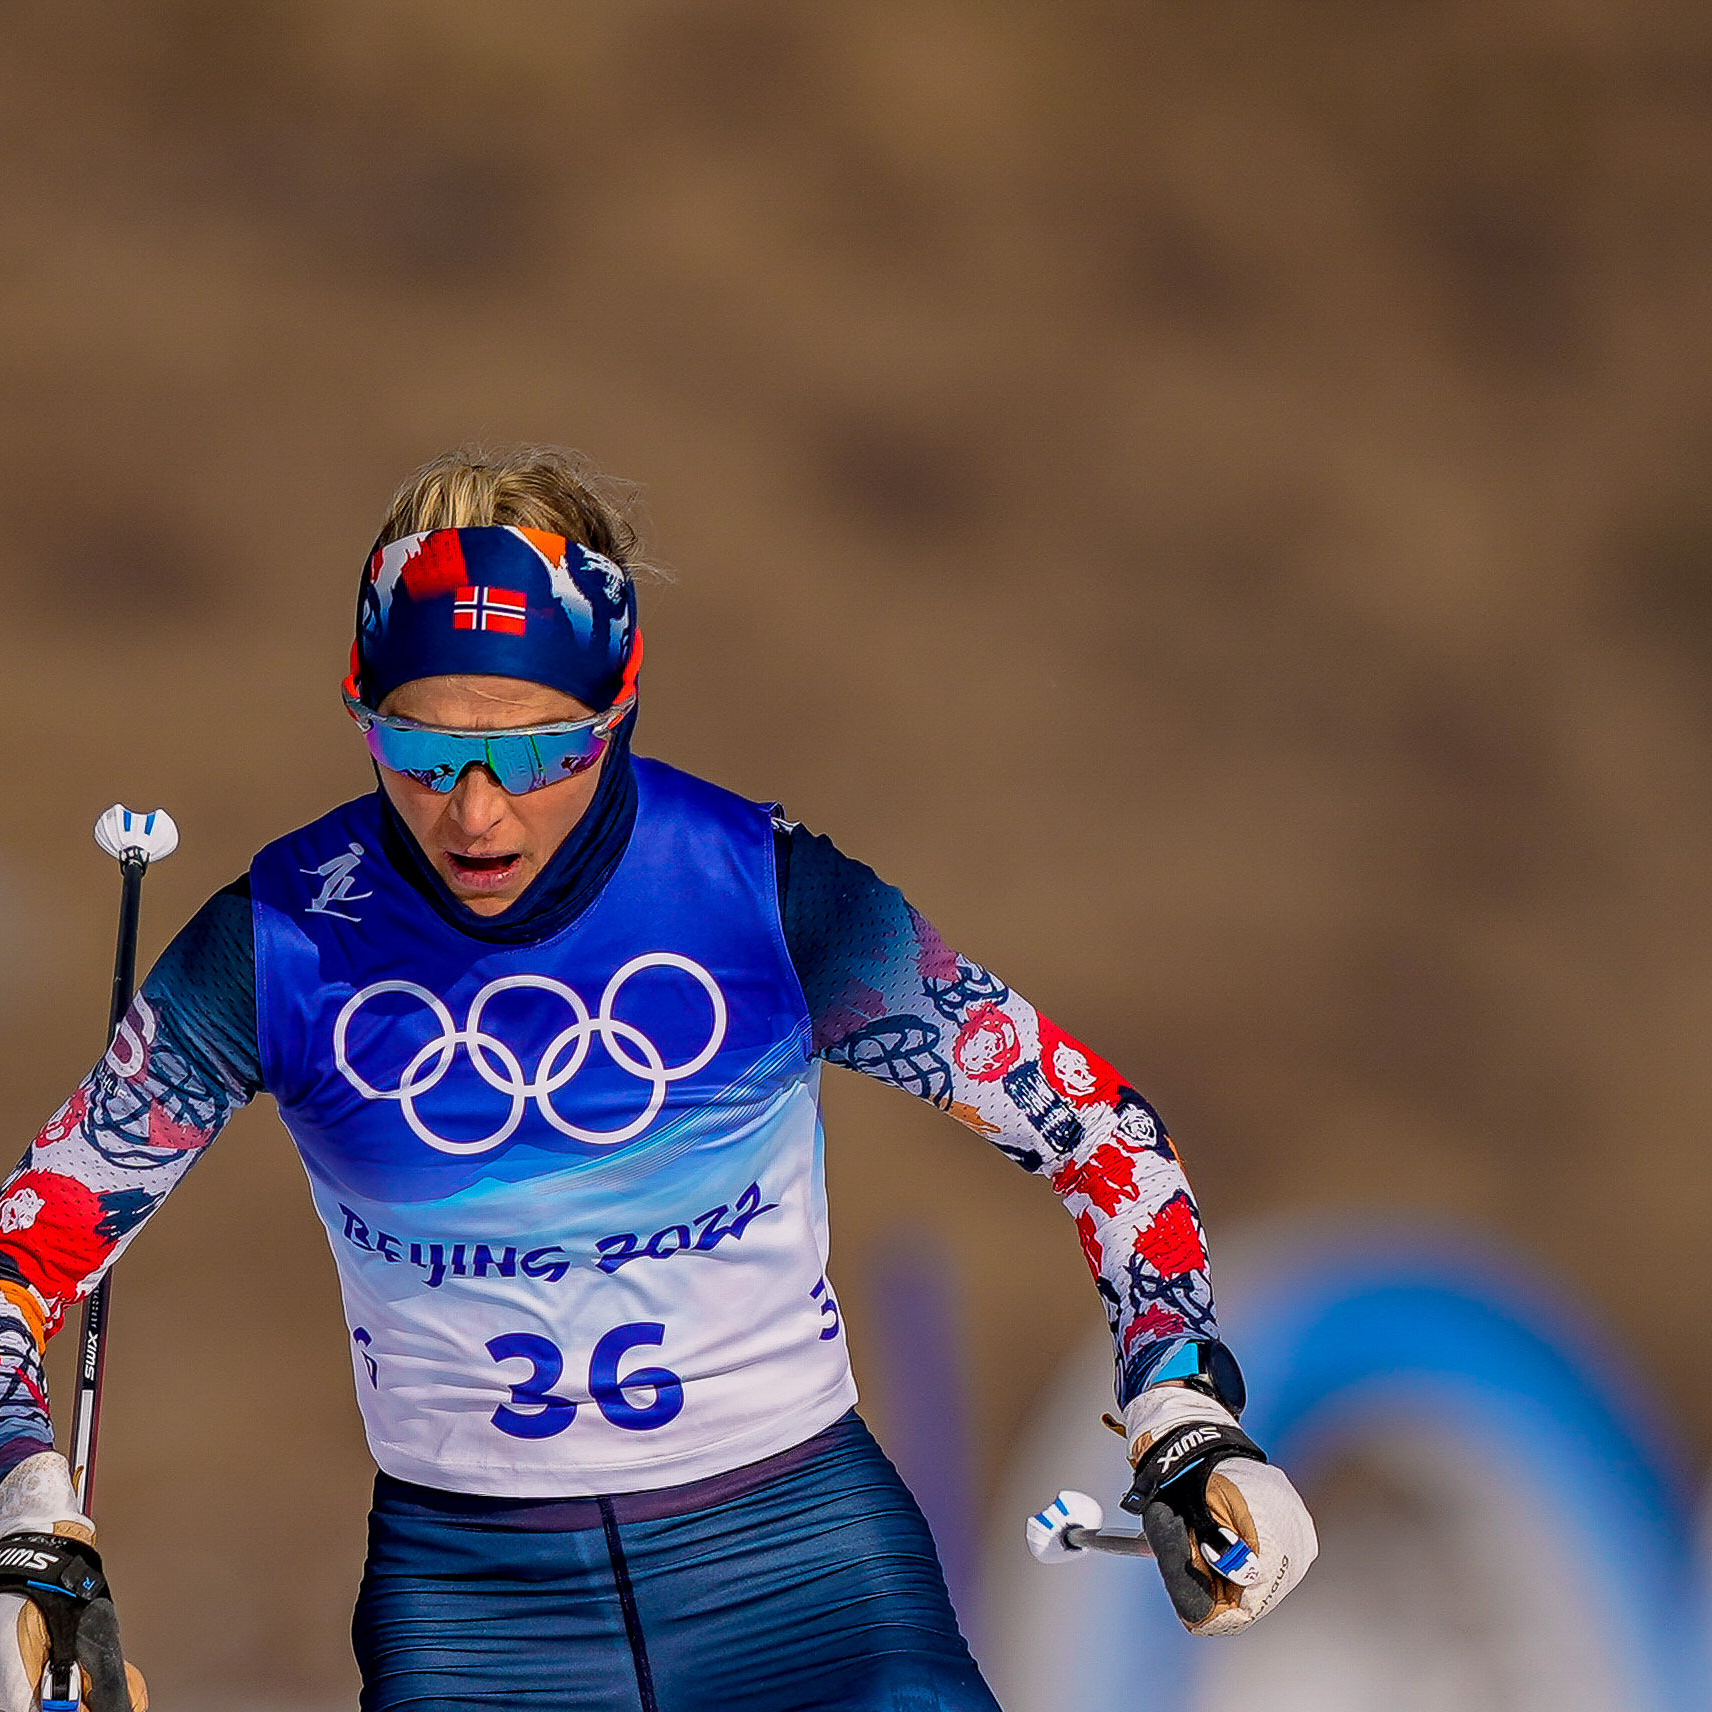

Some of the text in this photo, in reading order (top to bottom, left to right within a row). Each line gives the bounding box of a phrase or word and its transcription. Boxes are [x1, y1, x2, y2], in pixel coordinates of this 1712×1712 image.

[339, 1181, 780, 1288] BEIJING 2022
[84, 1330, 99, 1381] SWIX
[484, 1322, 685, 1439] 36
[1156, 1425, 1222, 1474] SWIX
